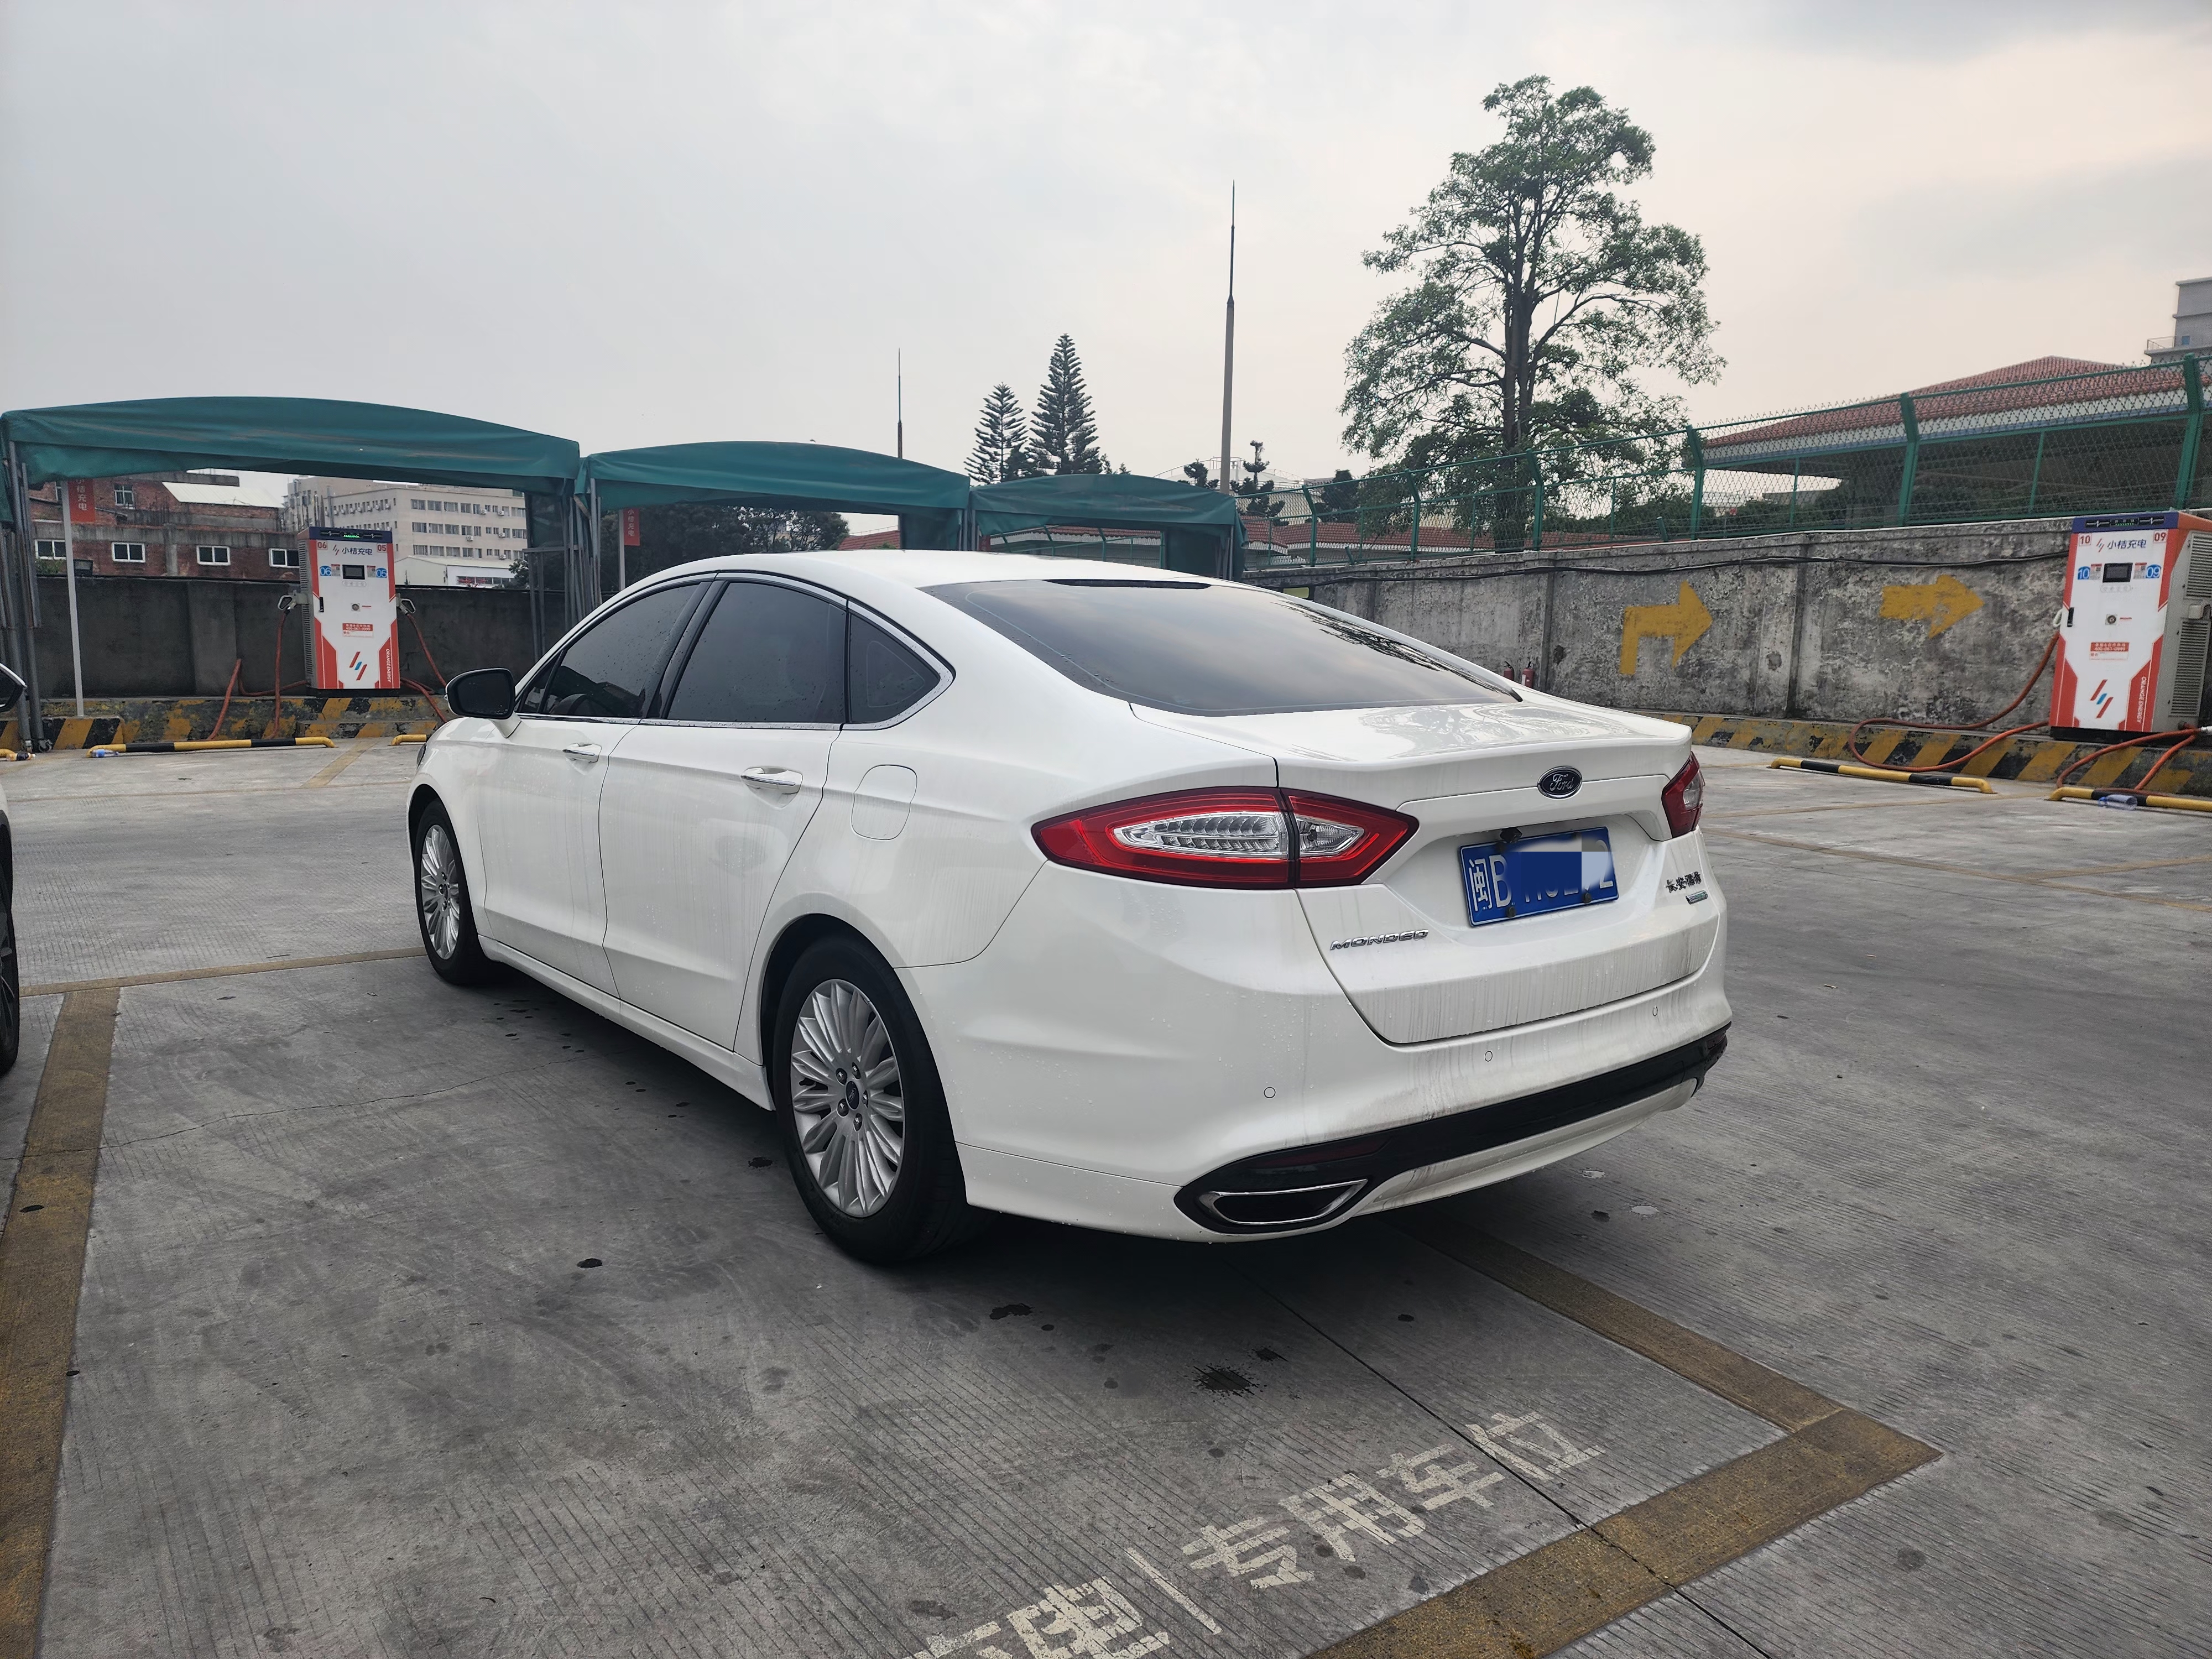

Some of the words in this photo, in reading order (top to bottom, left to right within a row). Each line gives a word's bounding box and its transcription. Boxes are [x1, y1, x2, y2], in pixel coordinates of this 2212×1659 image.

[2080, 535, 2090, 545] 10
[2154, 532, 2166, 541] 09
[2107, 539, 2147, 550] 小桔充电
[342, 547, 373, 556] 小桔充电
[320, 567, 331, 576] 06
[376, 569, 387, 577] 05
[2078, 568, 2090, 580] 10
[2146, 566, 2161, 578] 09
[1550, 773, 1574, 791] Ford
[1329, 929, 1429, 951] MONDEO
[1182, 1411, 1606, 1589] 专用车位
